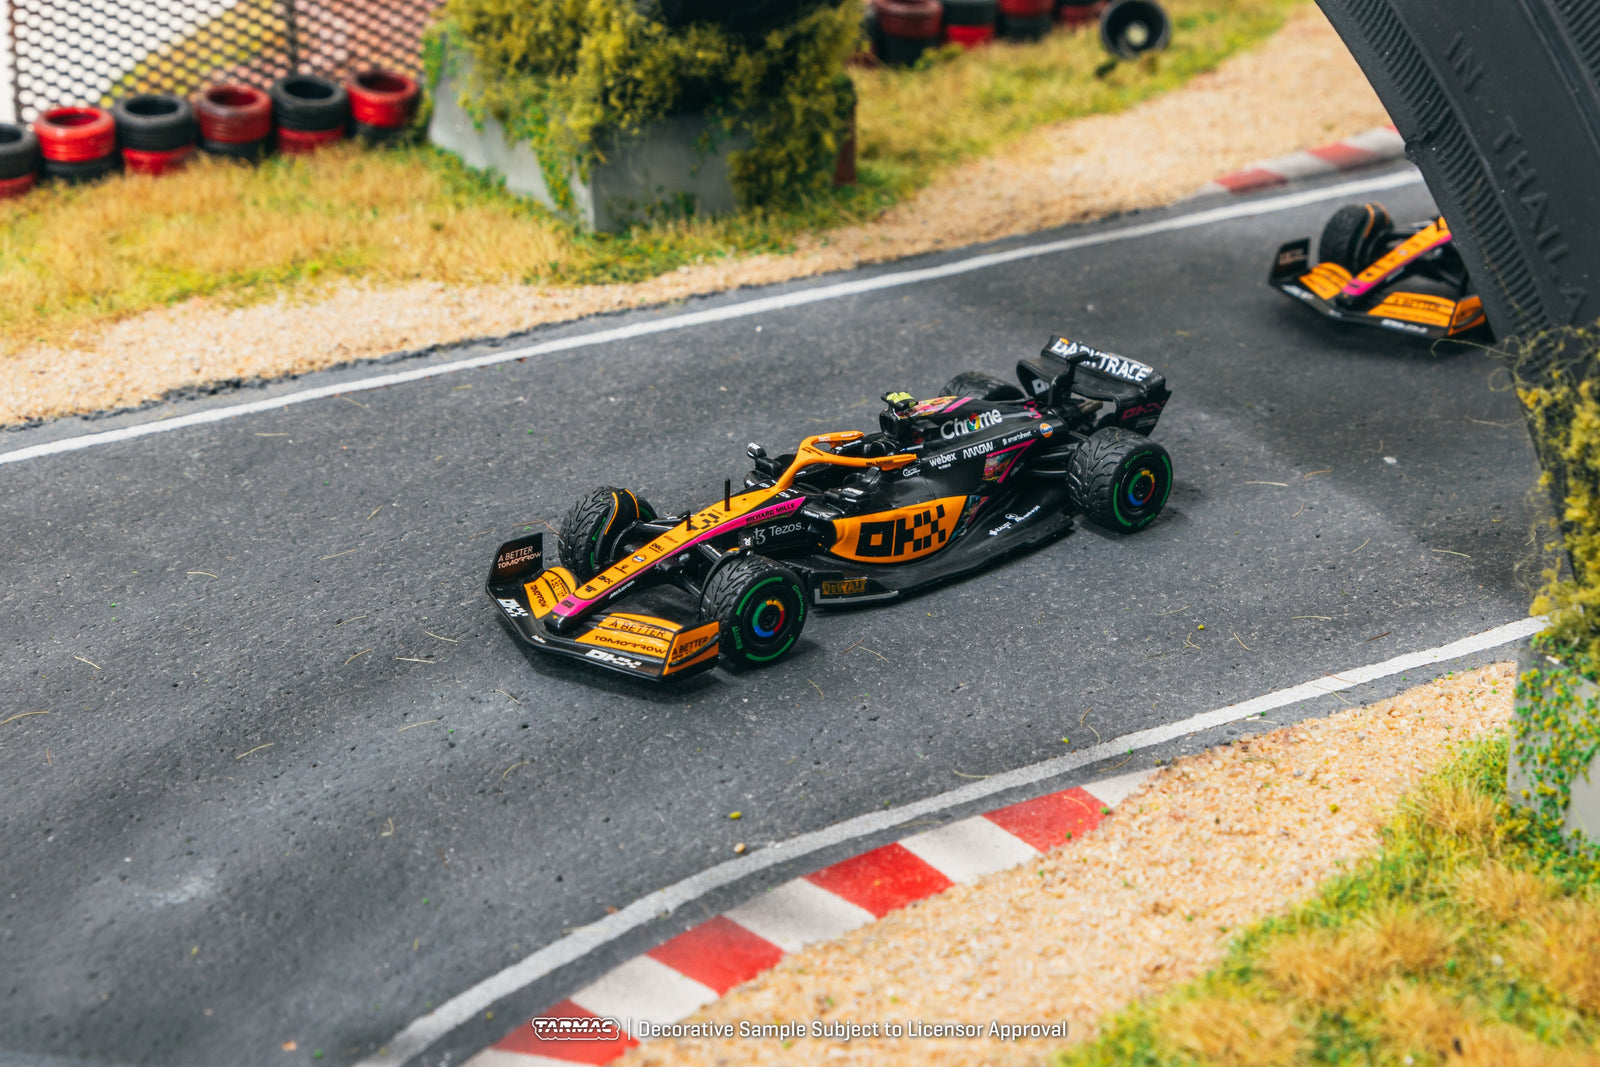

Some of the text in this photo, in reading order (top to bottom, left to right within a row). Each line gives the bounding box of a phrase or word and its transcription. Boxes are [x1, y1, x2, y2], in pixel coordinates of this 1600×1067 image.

[1447, 31, 1485, 93] IN
[940, 408, 1003, 439] Chrome
[929, 452, 958, 467] webex
[745, 502, 796, 525] RICHARD MILLE
[768, 521, 803, 537] Tezos
[855, 504, 946, 558] OKX
[497, 545, 534, 563] A BETTER
[497, 551, 542, 569] TOMORROW
[608, 619, 668, 638] A BETTER
[594, 635, 667, 655] TOMORROW
[672, 648, 679, 657] A
[679, 636, 709, 654] BETTER
